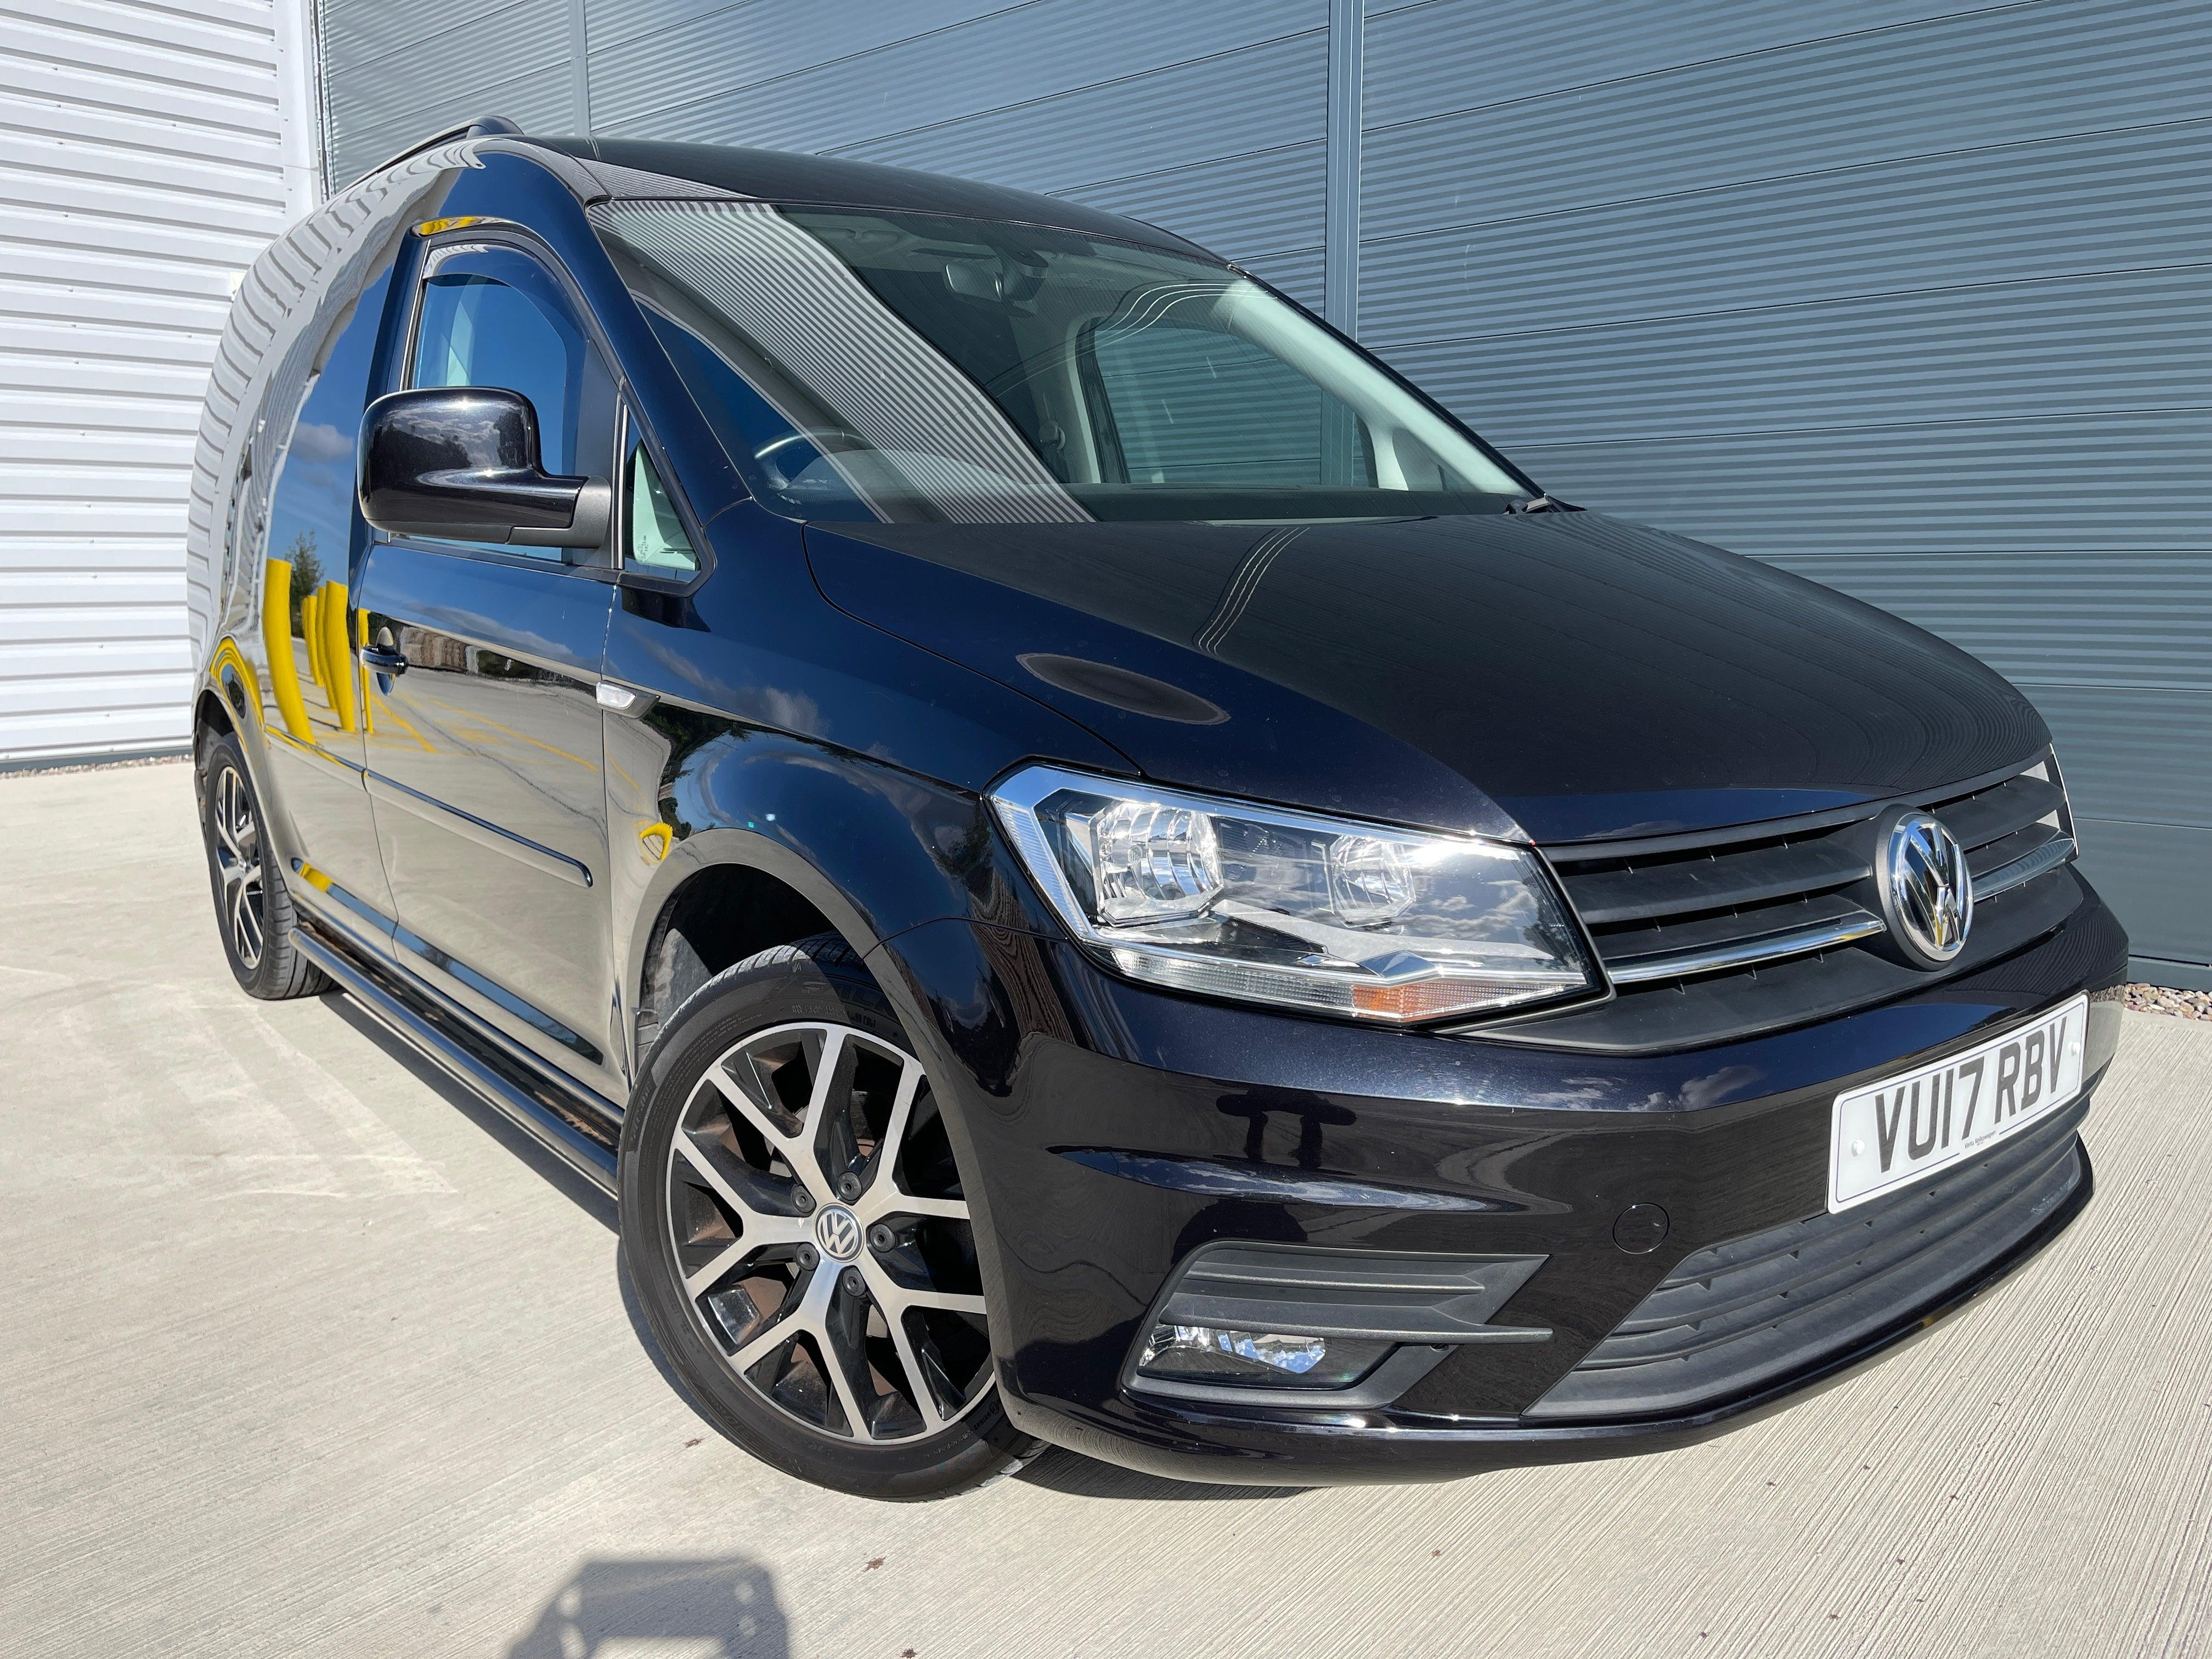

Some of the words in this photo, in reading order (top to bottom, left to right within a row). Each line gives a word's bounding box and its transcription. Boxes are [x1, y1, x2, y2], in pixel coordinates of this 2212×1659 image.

[1875, 1056, 1985, 1173] VU17
[1994, 1016, 2067, 1125] RBV
[1975, 1130, 1996, 1144] Volkswagen
[819, 1211, 857, 1255] VW
